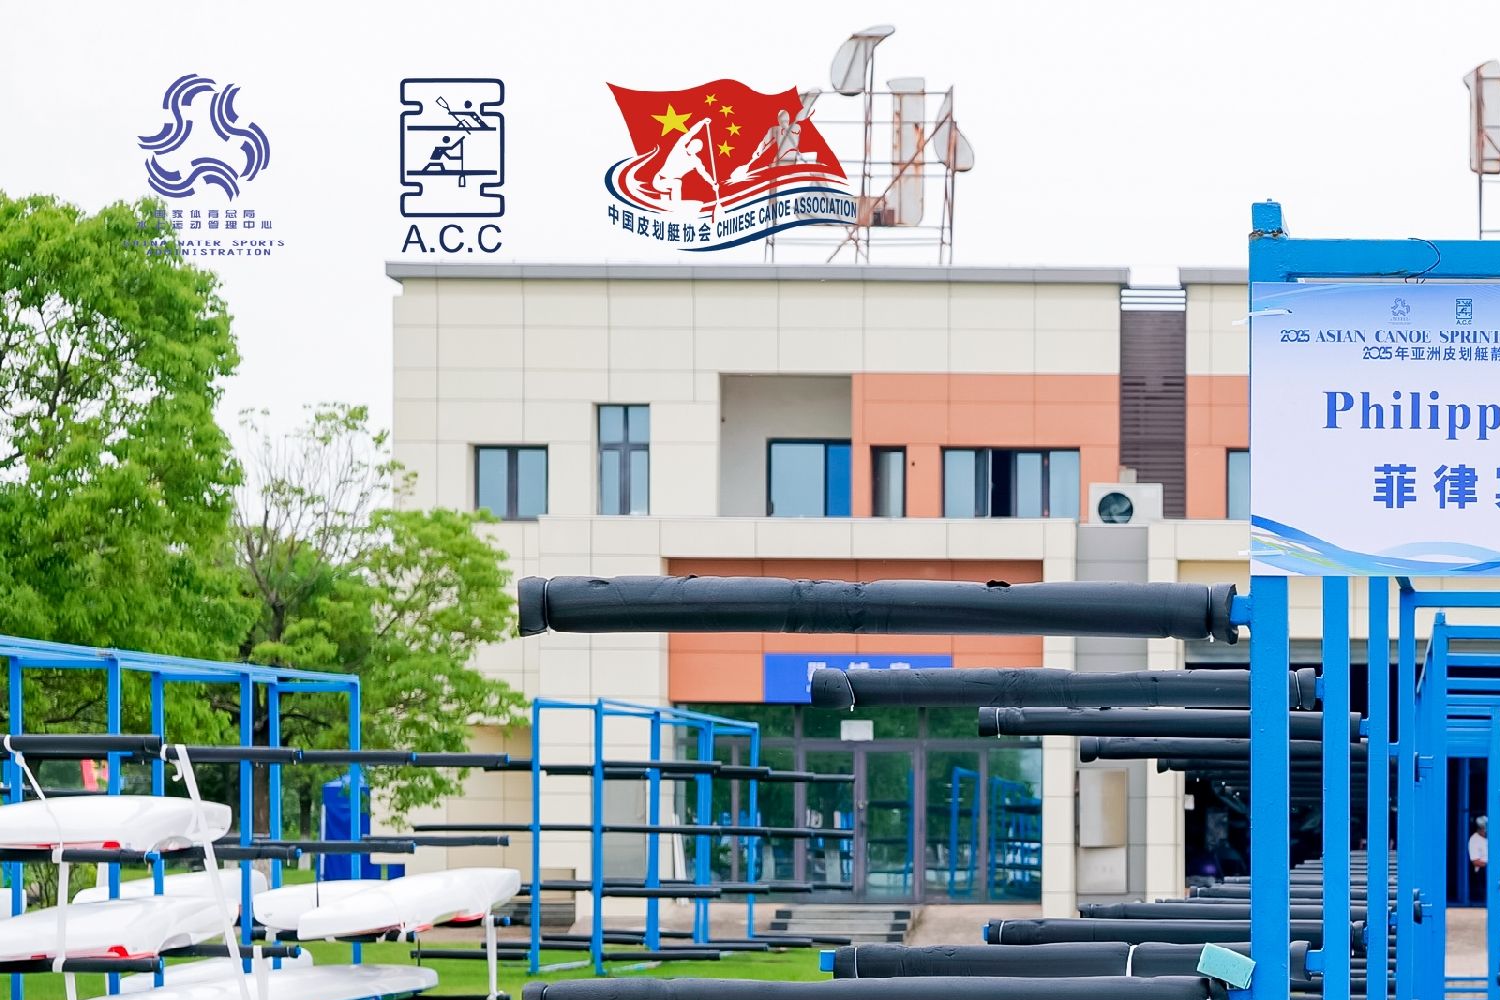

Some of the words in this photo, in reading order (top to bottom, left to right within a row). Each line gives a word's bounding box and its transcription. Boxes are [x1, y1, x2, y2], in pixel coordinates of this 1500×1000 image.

[1280, 330, 1310, 343] 2025
[1315, 330, 1366, 344] ASIAN
[1375, 330, 1431, 344] CANOE
[1439, 330, 1500, 344] SPRINT
